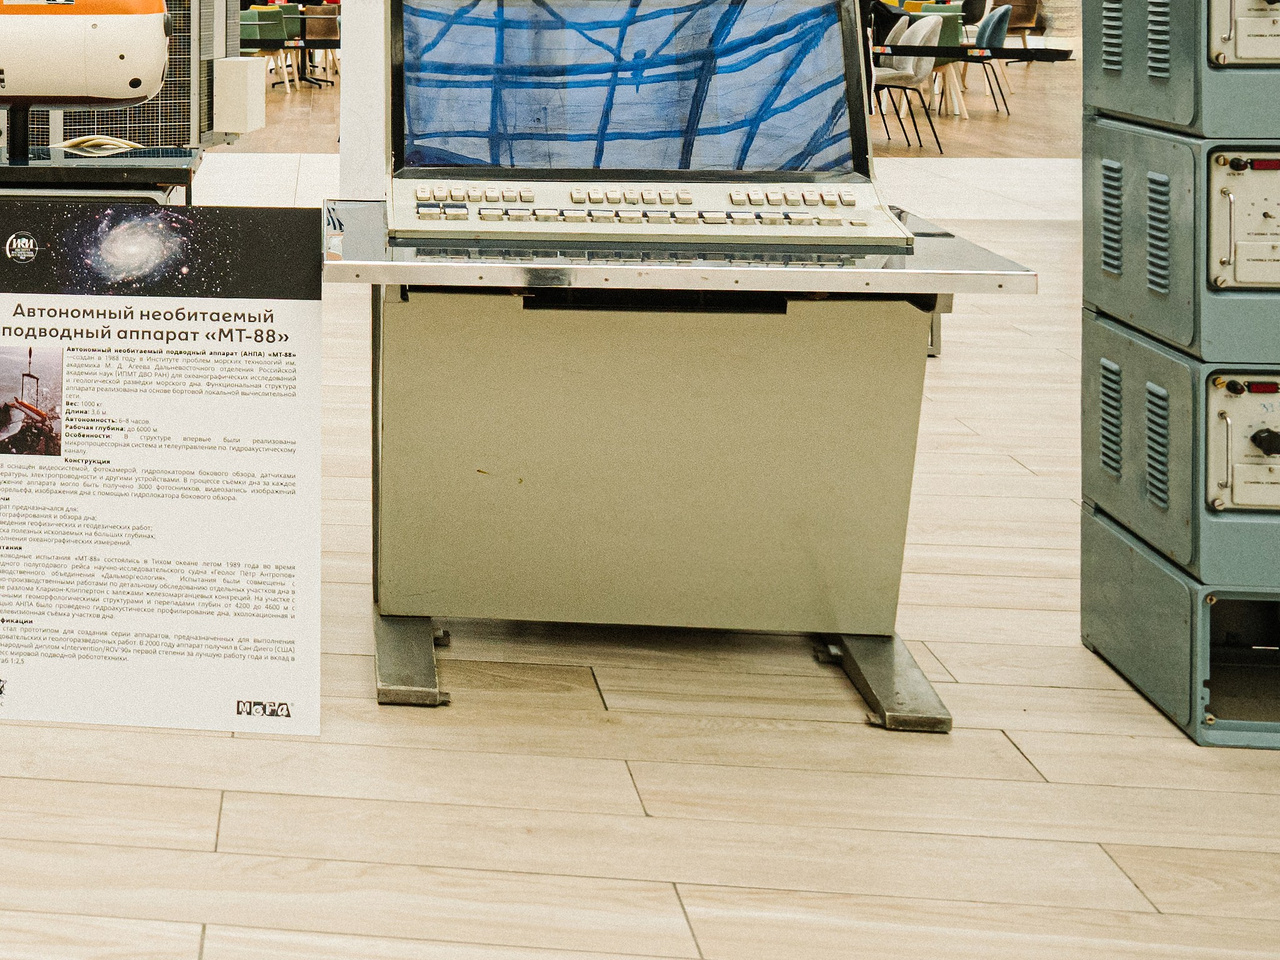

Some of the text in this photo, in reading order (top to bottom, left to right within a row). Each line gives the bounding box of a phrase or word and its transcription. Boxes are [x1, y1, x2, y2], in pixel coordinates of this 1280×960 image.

[12, 303, 274, 324] Автономный необитаемый
[2, 324, 290, 344] подводный аппарат «МТ-88»
